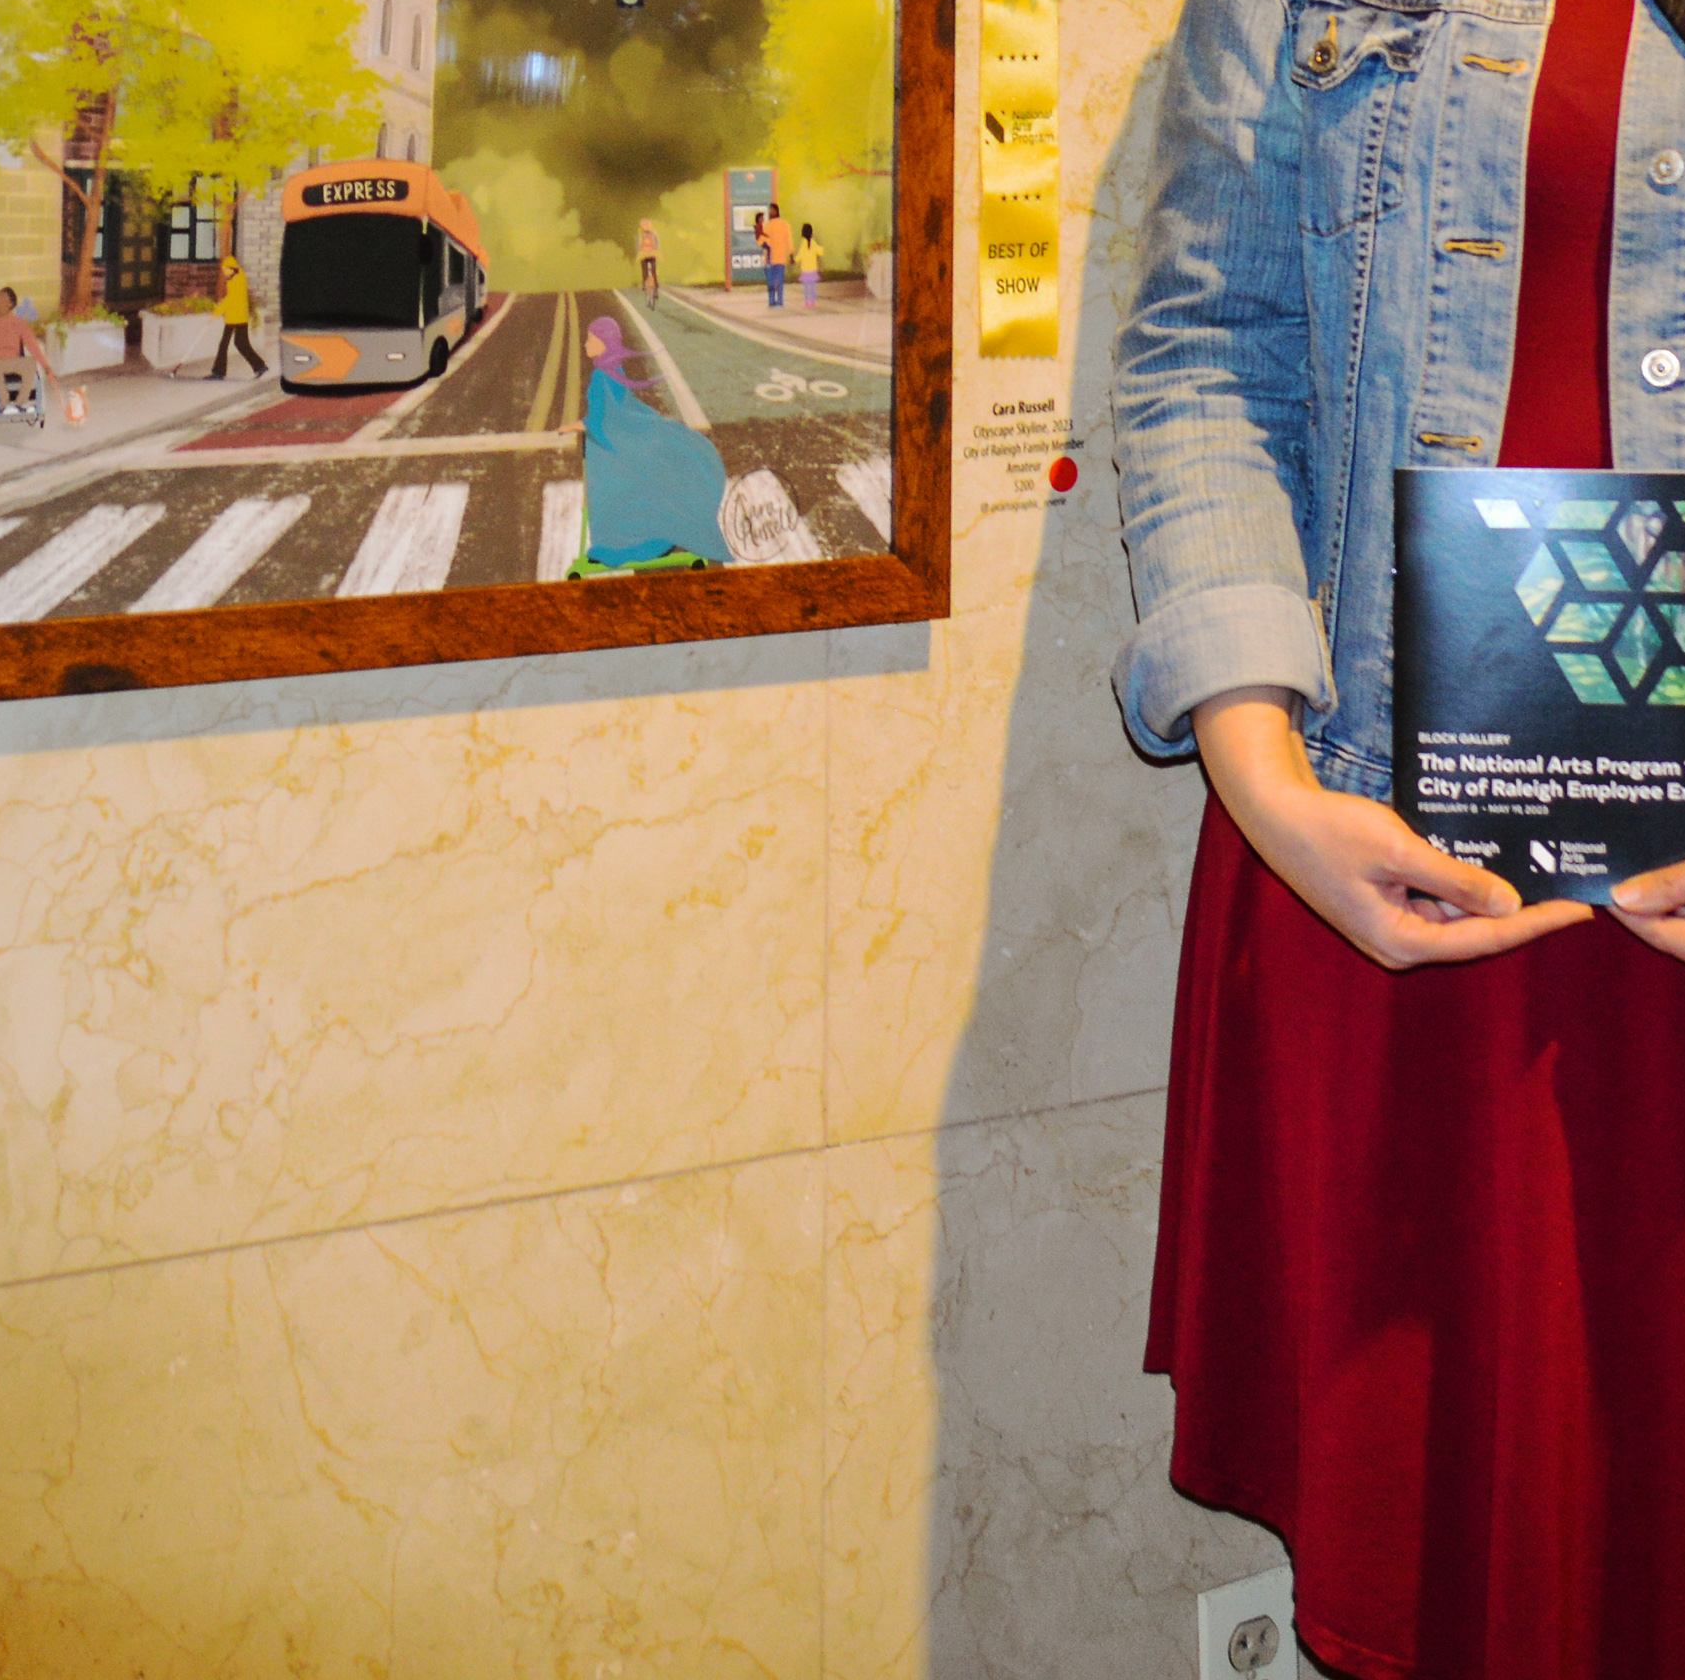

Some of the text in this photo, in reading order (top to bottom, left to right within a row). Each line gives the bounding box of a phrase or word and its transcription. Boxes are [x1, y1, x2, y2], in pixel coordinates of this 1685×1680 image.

[322, 180, 396, 203] EXPRESS
[988, 241, 1050, 259] BEST OF
[996, 277, 1040, 295] SHOW
[992, 398, 1055, 417] Cara Russell
[973, 425, 1014, 440] Cityscape
[1052, 419, 1074, 433] 2023
[963, 446, 979, 460] City
[980, 444, 990, 457] of
[991, 442, 1021, 457] Raleigh
[1023, 441, 1050, 455] Family
[1006, 461, 1041, 473] Amateur
[1418, 731, 1512, 746] BLOCK GALLERY
[1417, 752, 1457, 773] The
[1459, 754, 1545, 774] National
[1546, 755, 1594, 775] Arts
[1596, 756, 1682, 781] Program
[1418, 776, 1462, 800] City
[1464, 777, 1490, 797] of
[1491, 778, 1564, 803] Raleigh
[1566, 780, 1665, 804] Employee
[1417, 801, 1469, 814] FEBRUARY
[1453, 839, 1501, 858] Raleigh
[1559, 840, 1608, 854] National
[1559, 861, 1609, 877] Program
